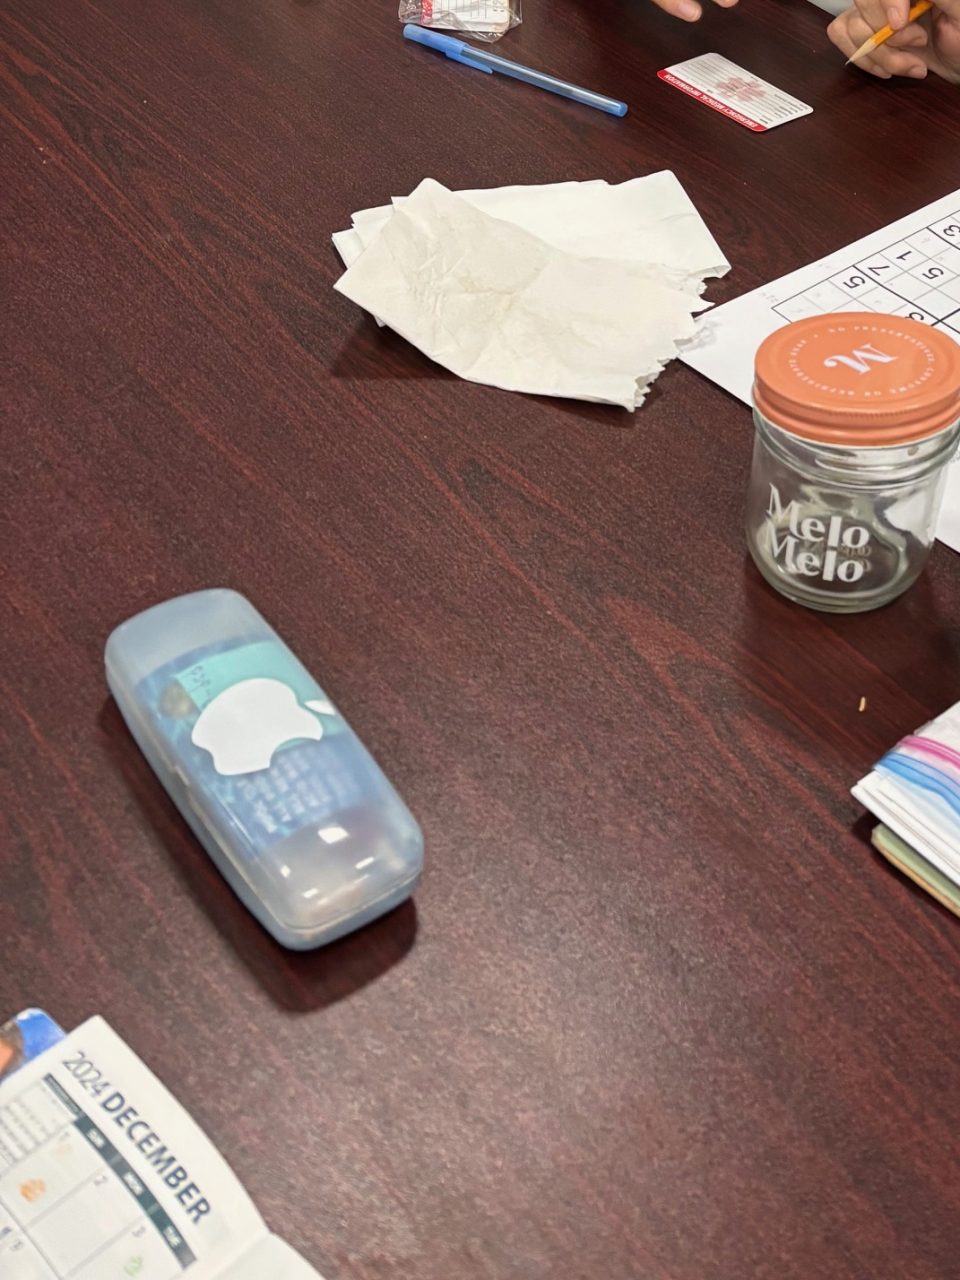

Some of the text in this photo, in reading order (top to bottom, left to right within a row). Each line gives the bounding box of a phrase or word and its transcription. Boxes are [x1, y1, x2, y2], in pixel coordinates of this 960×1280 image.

[843, 273, 866, 289] 5
[868, 264, 890, 276] 7
[896, 249, 912, 261] 1
[922, 265, 944, 280] 5
[767, 482, 870, 549] Melo
[766, 518, 865, 583] Melo
[61, 1050, 111, 1097] 2024
[99, 1090, 211, 1224] DECEMBER
